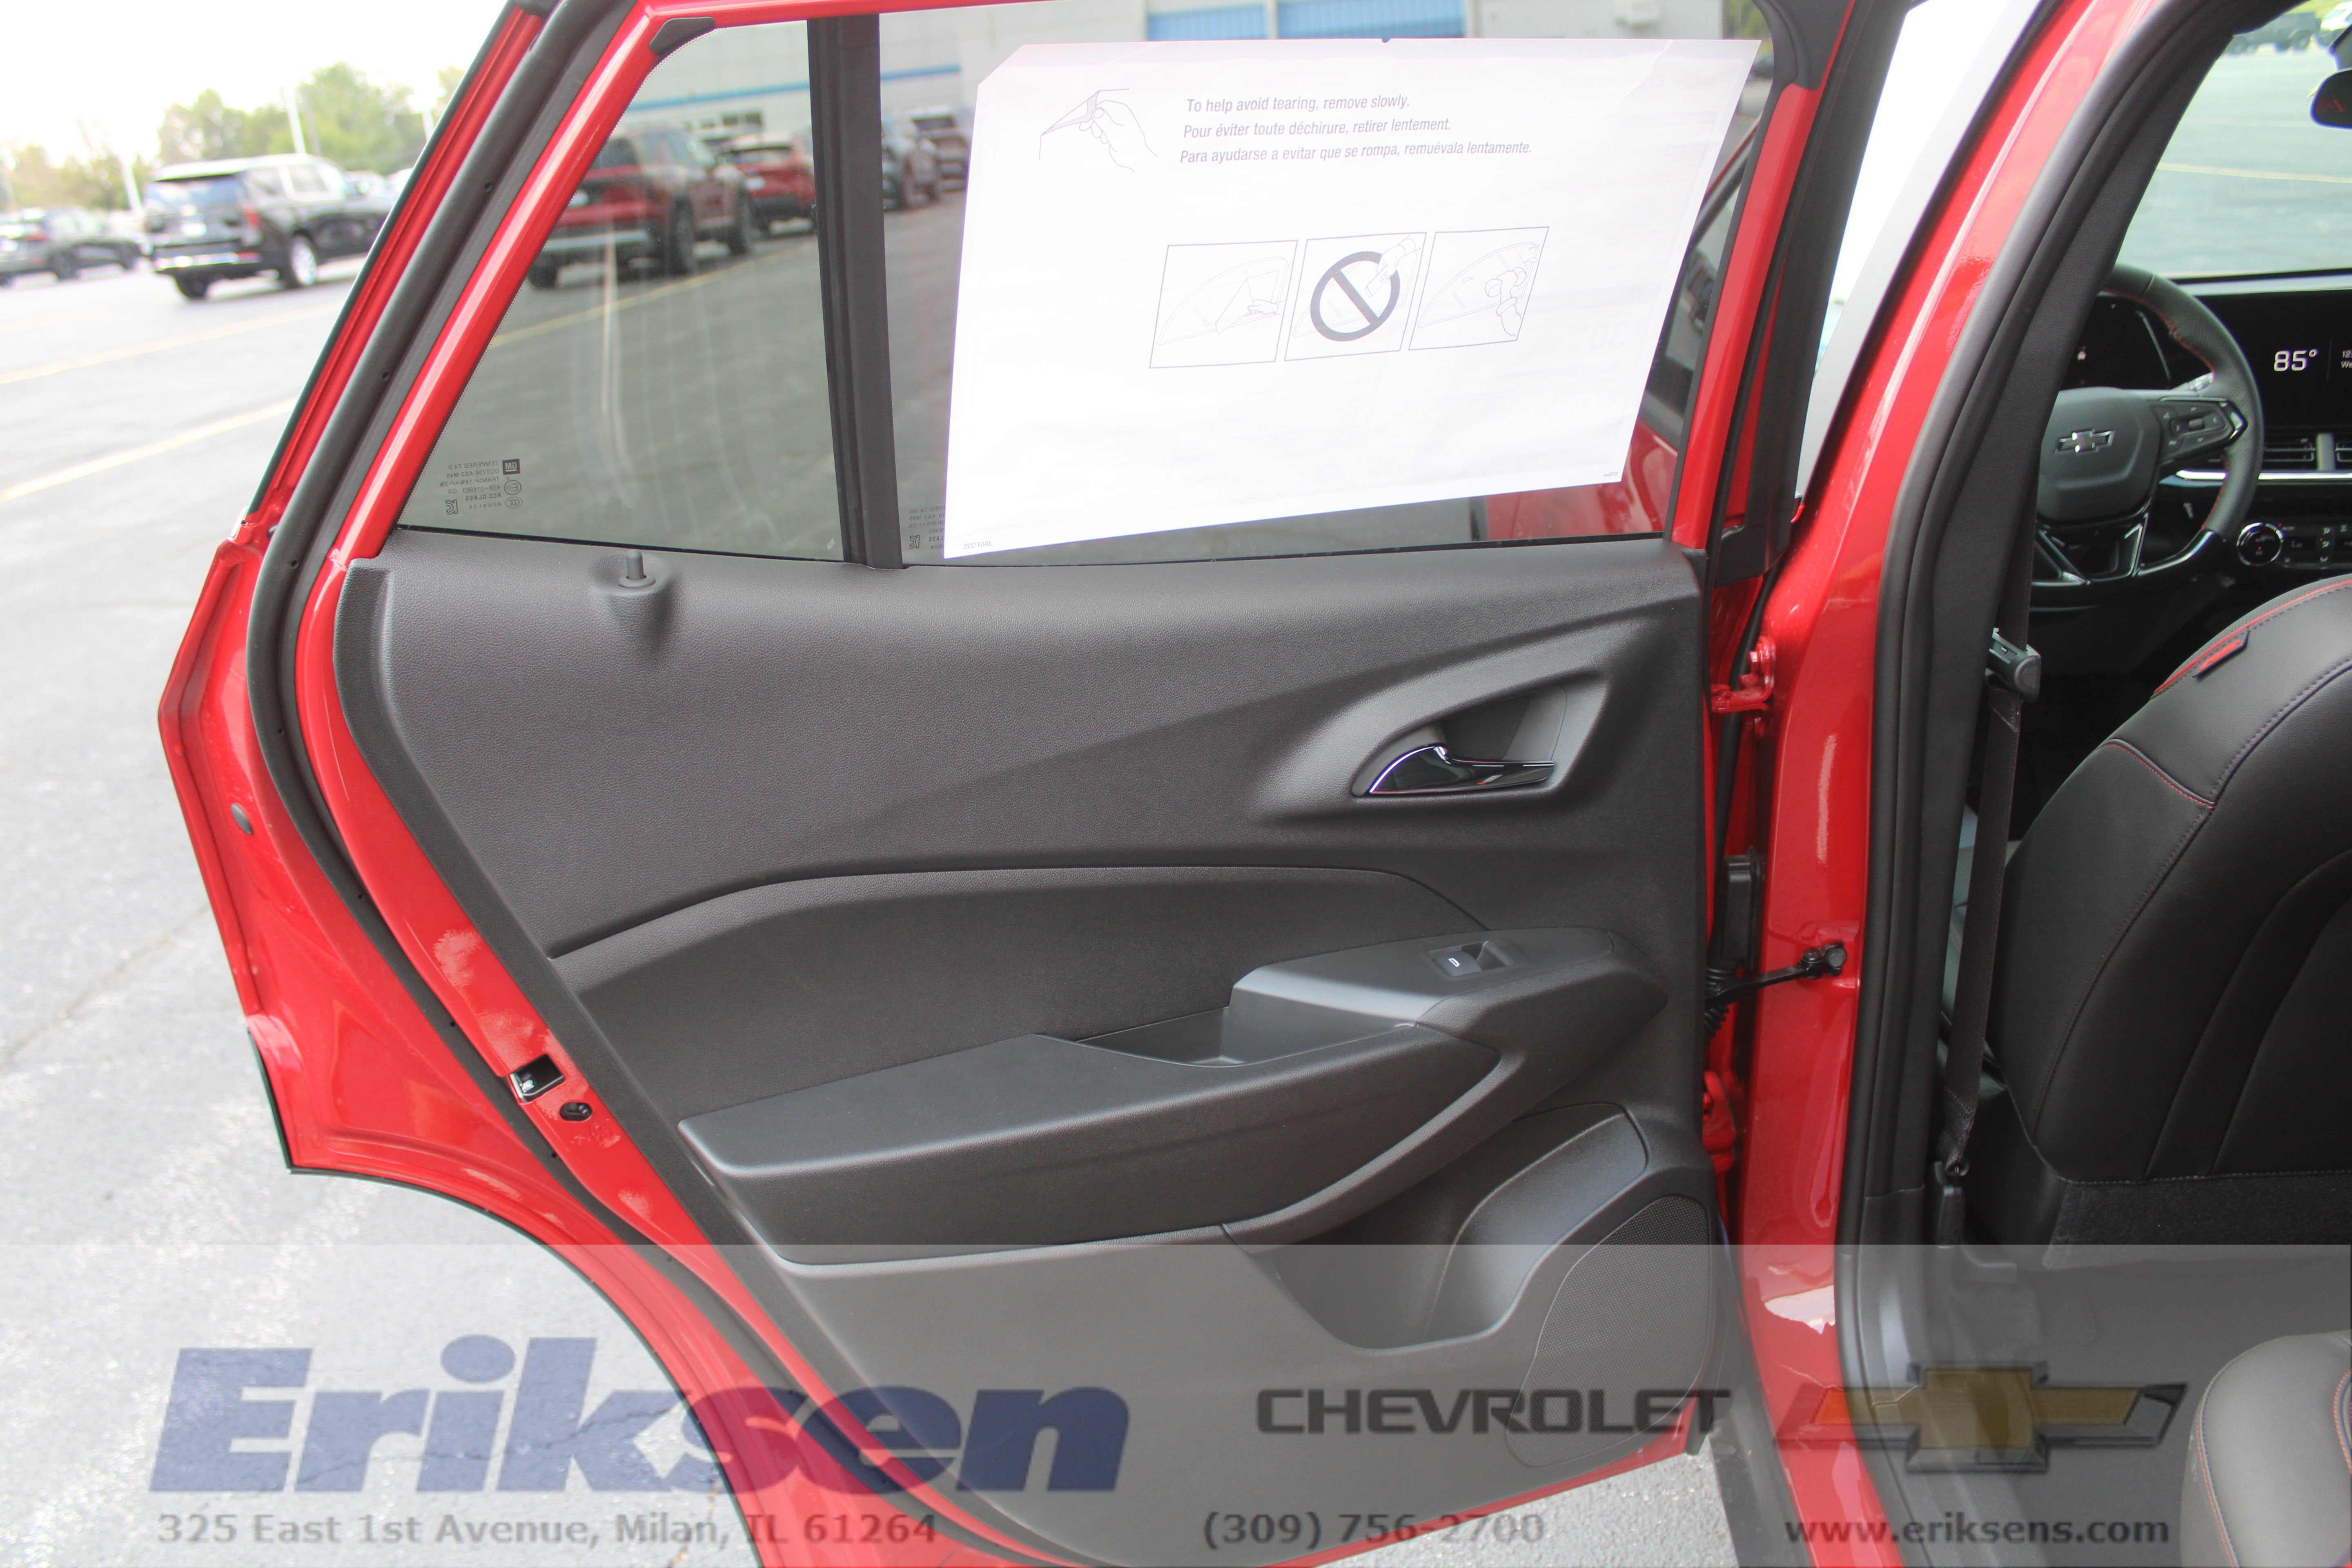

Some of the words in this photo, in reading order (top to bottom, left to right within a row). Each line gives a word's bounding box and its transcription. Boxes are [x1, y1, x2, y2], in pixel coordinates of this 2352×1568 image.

[1187, 99, 1201, 112] To
[1206, 98, 1232, 115] help
[1236, 97, 1269, 111] avoid
[1273, 96, 1319, 113] tearing,
[1323, 98, 1368, 109] remove
[1370, 94, 1410, 109] slowly.
[1183, 125, 1213, 138] Pour
[1216, 123, 1251, 137] éviter
[1254, 122, 1285, 135] toute
[1289, 121, 1348, 136] déchirure,
[1352, 120, 1388, 133] retirer
[1391, 118, 1451, 131] lentement.
[1180, 150, 1207, 163] Para
[1211, 148, 1267, 164] ayudarse
[1271, 150, 1278, 160] a
[1283, 147, 1317, 160] evitar
[1320, 148, 1341, 161] que
[1344, 147, 1358, 158] se
[1361, 145, 1400, 159] rompa,
[1404, 141, 1464, 155] remuévala
[1466, 141, 1531, 154] lentamente.
[2274, 349, 2317, 372] 85°
[962, 540, 993, 550] 202104L
